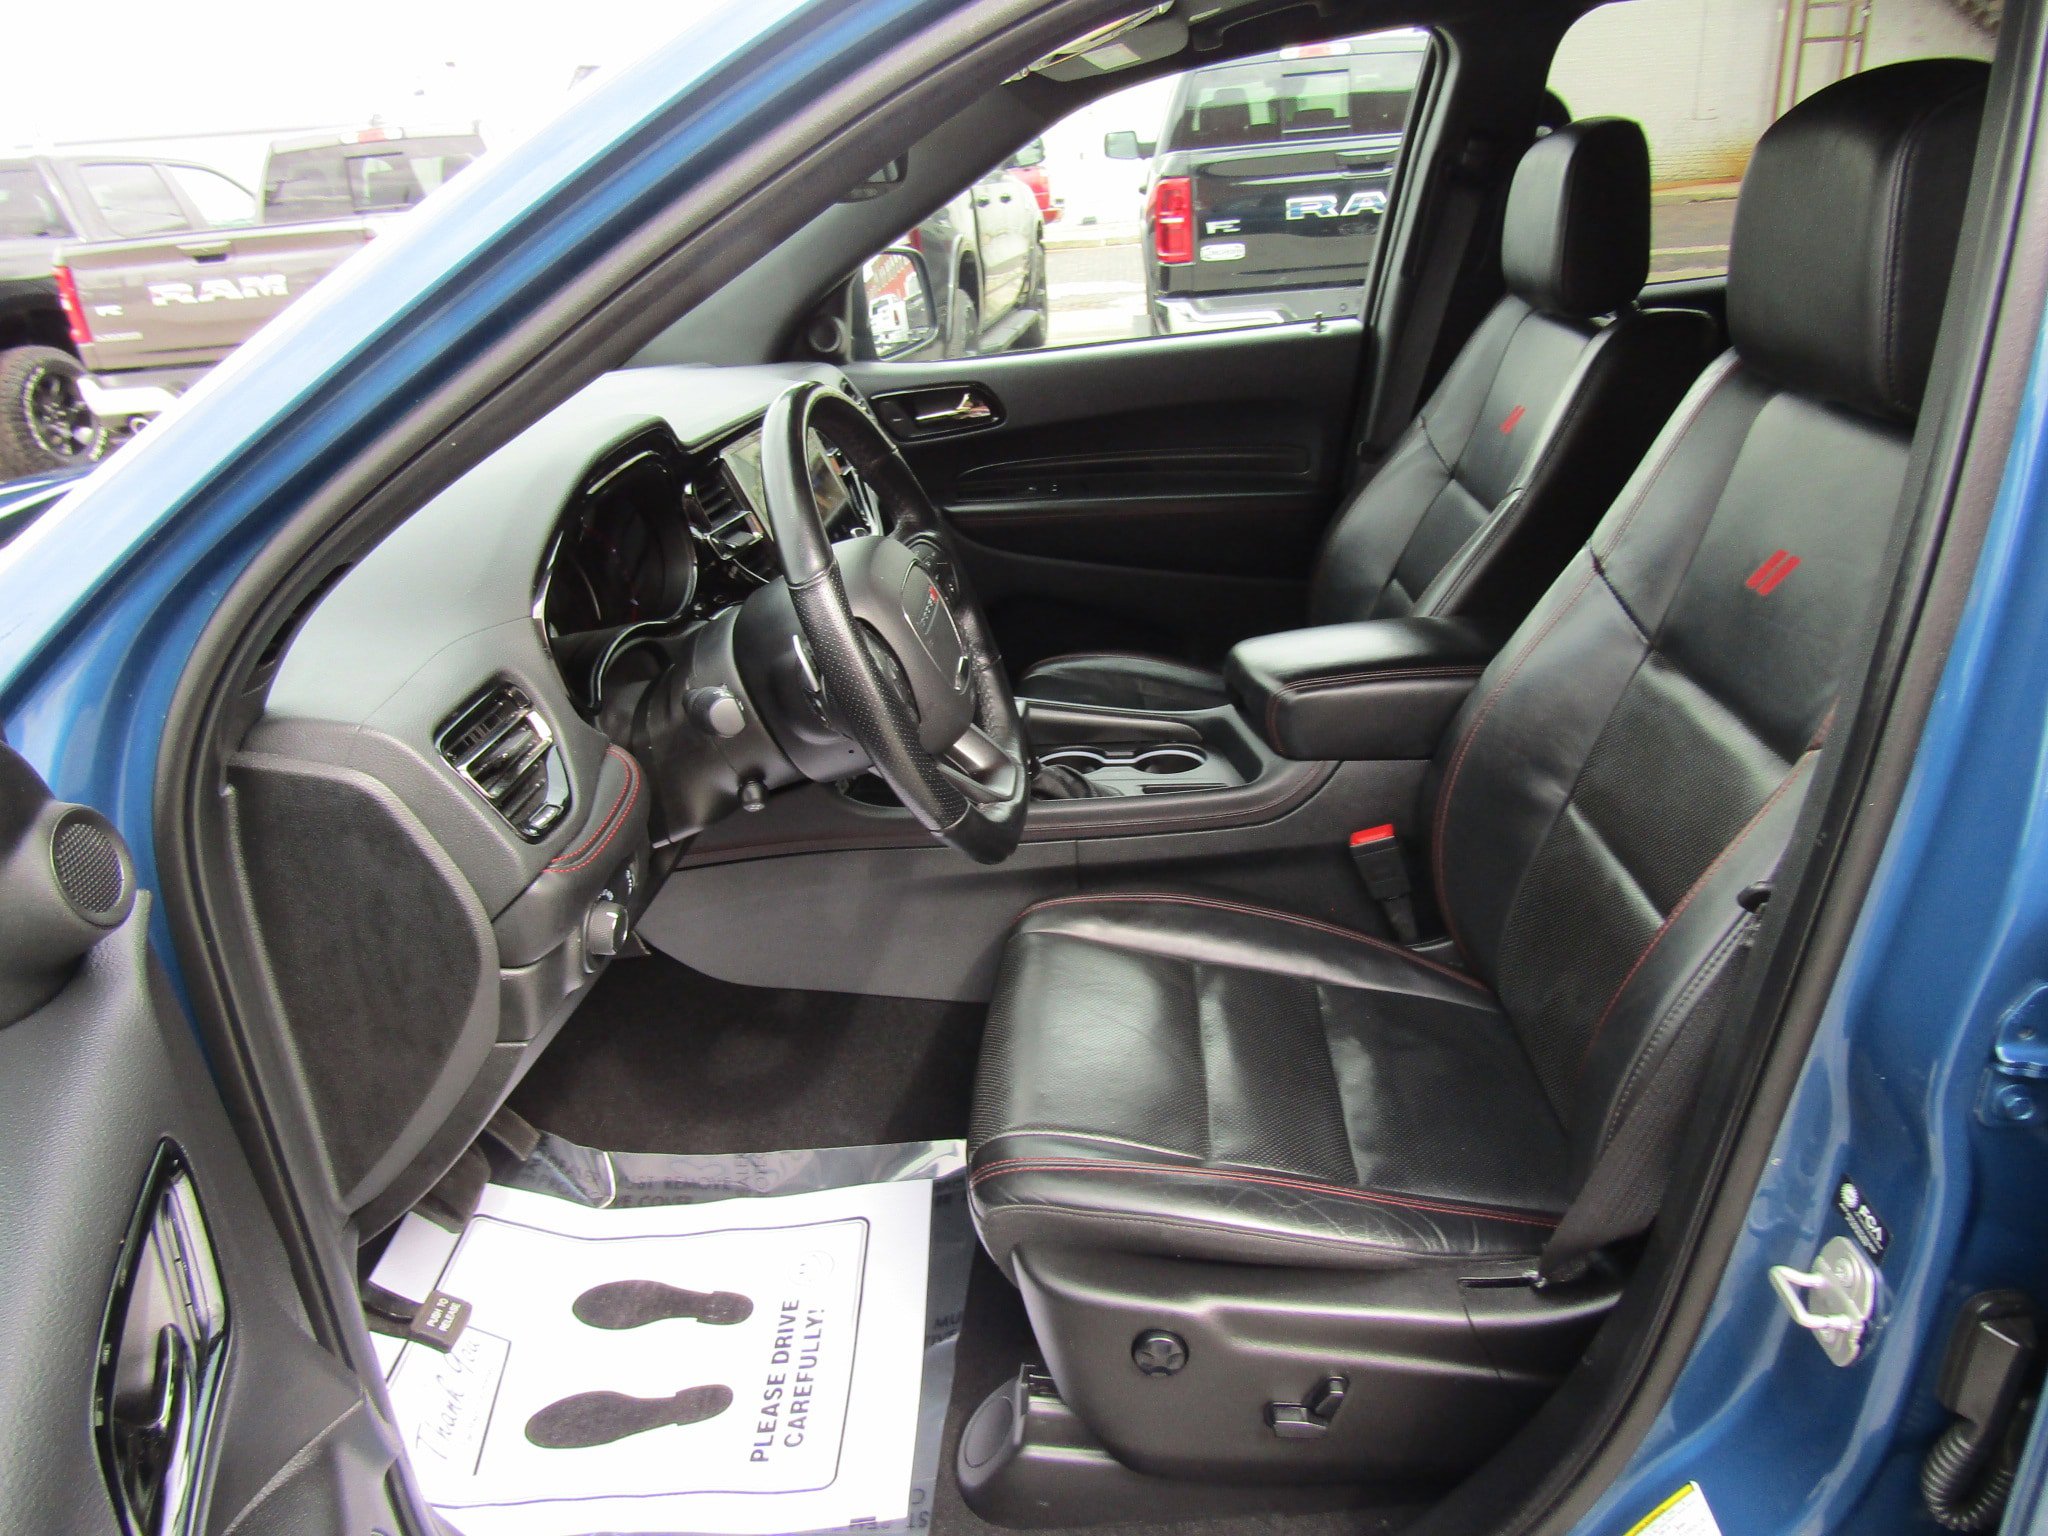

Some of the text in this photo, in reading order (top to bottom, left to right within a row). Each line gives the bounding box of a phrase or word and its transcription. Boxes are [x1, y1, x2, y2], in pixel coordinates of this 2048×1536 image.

[1285, 191, 1388, 221] RA
[147, 274, 290, 307] RAM
[426, 1297, 449, 1327] PUSH TO
[438, 1302, 461, 1331] RELEASE
[750, 1299, 800, 1462] PLEASE DRIVE
[784, 1309, 825, 1447] CAREFULLY!
[416, 1374, 465, 1459] Thank
